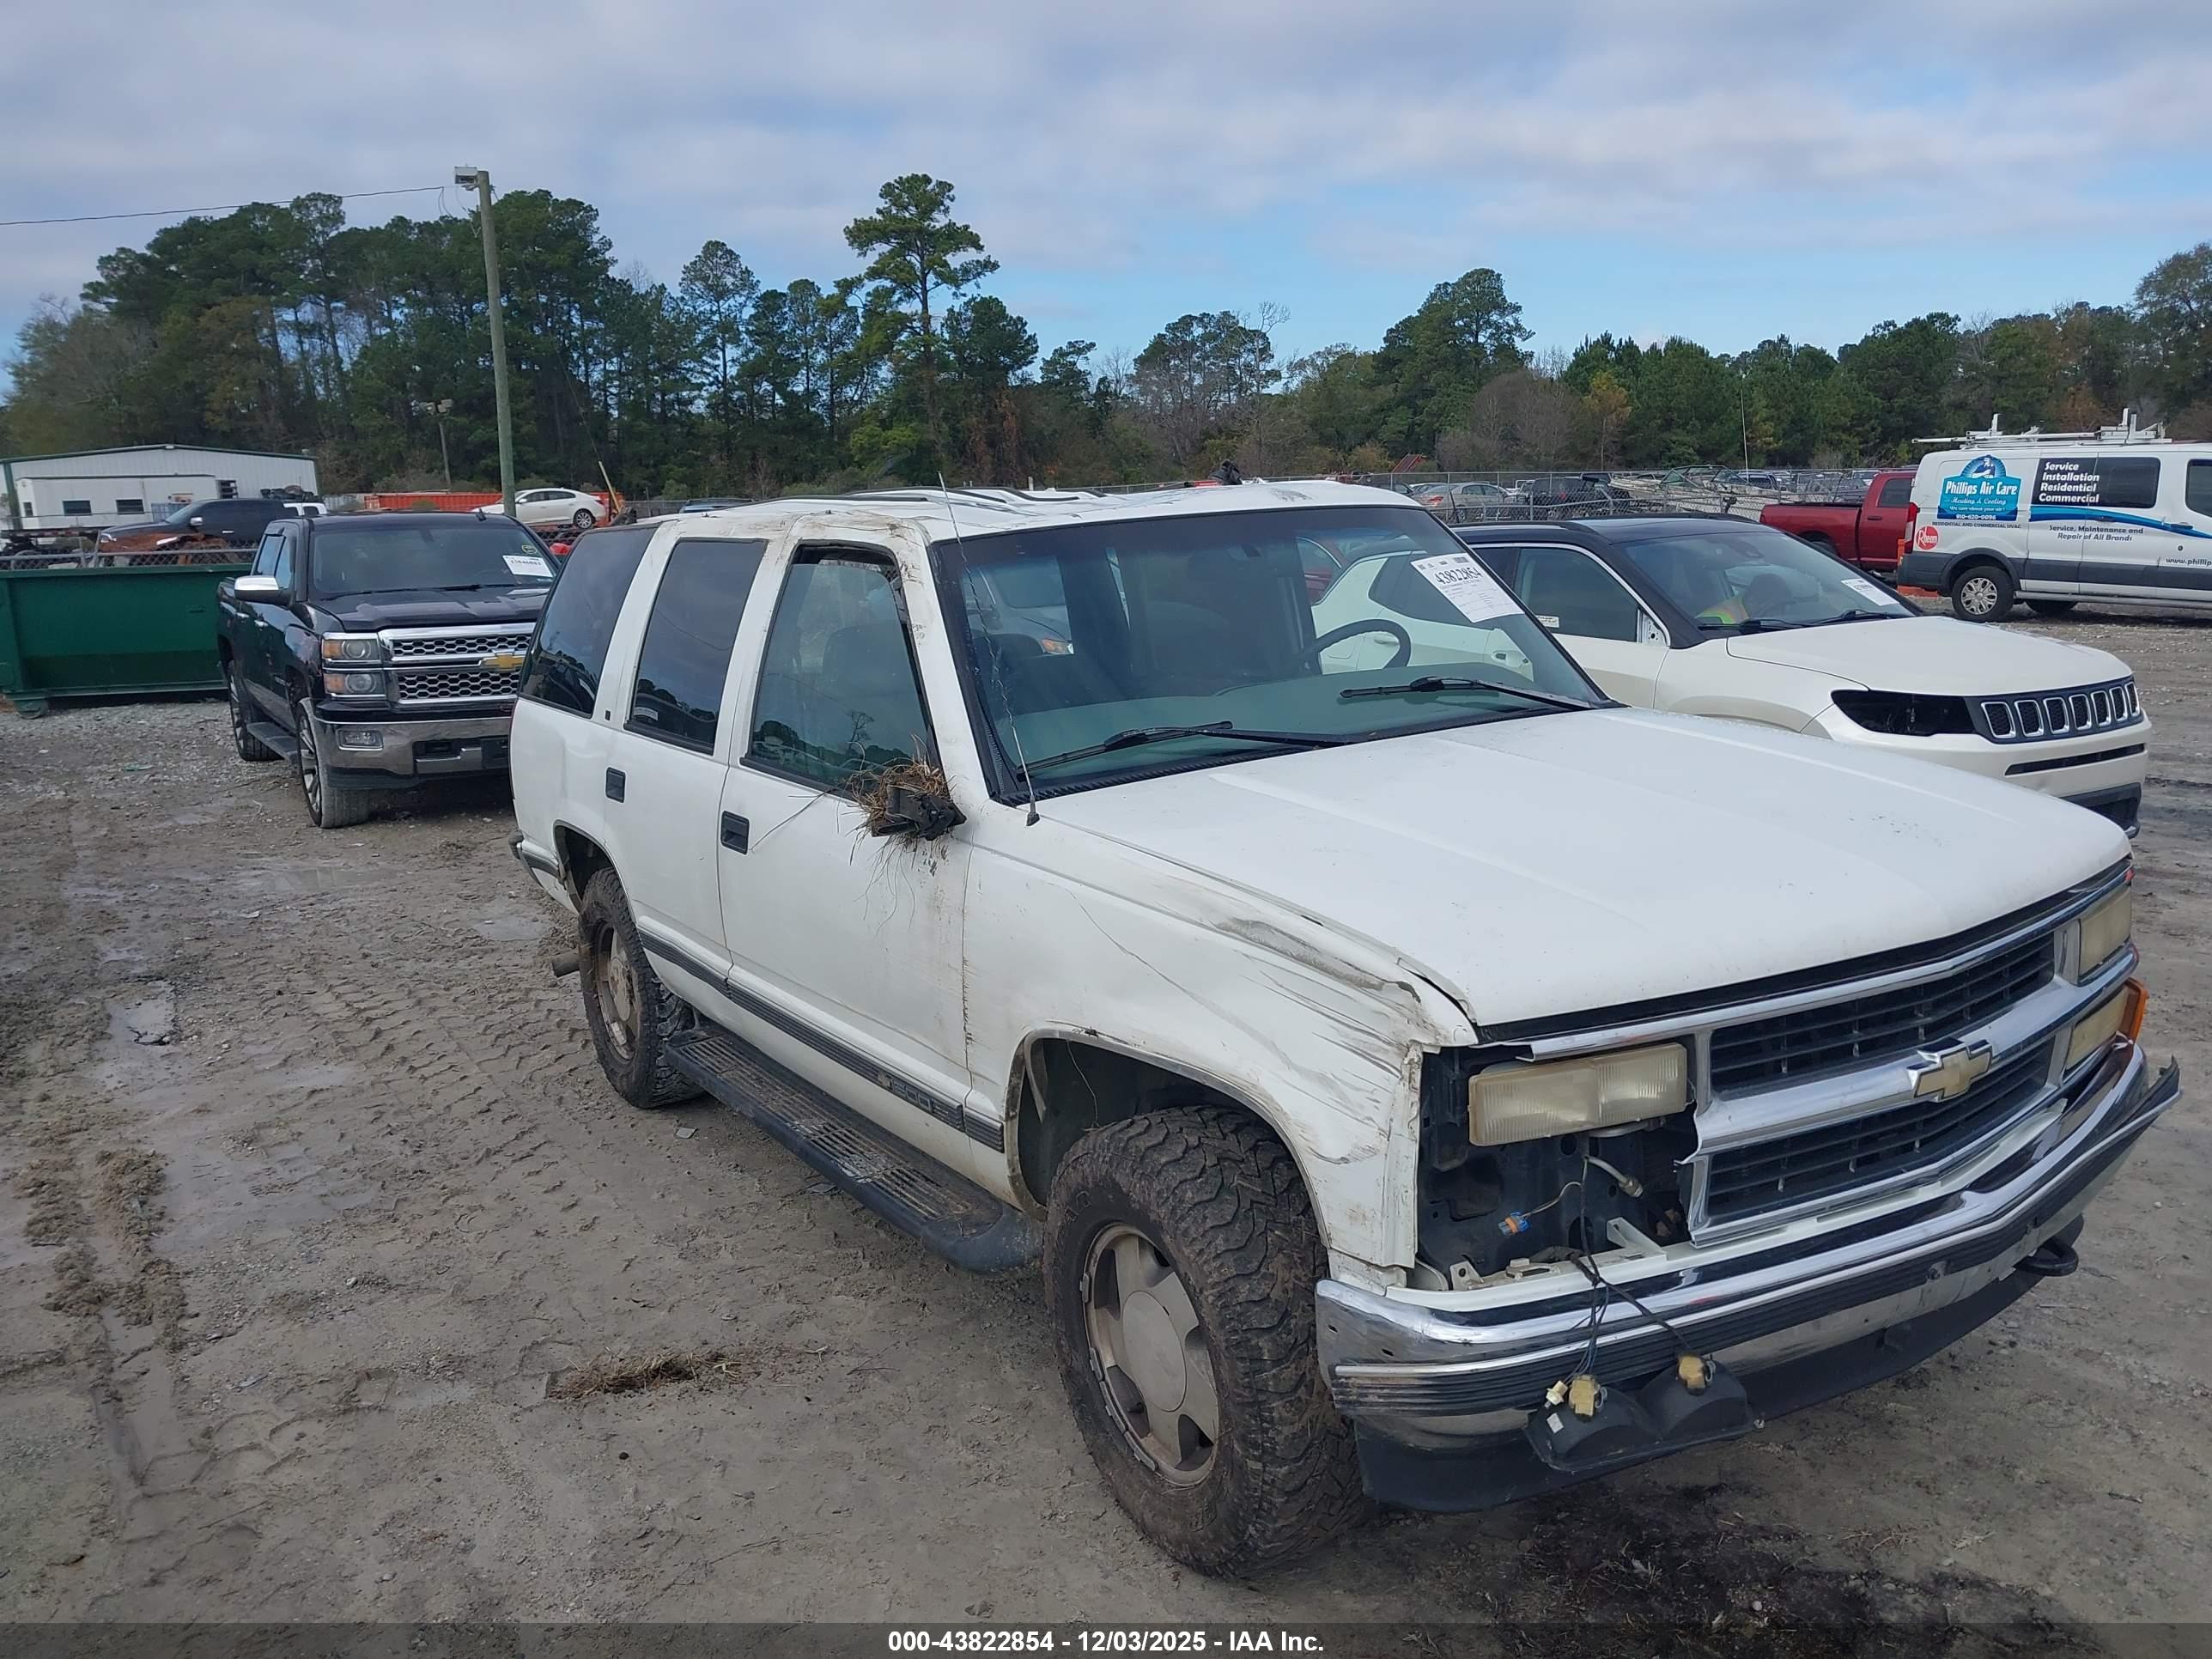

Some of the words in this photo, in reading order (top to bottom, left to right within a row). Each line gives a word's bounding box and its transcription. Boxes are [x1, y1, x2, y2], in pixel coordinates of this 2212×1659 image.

[2045, 461, 2079, 471] Service
[2042, 471, 2100, 481] Installation
[1945, 480, 1977, 495] Phillips
[1980, 481, 1994, 495] Air
[1996, 481, 2018, 495] Care
[2040, 482, 2097, 492] Residential
[2039, 492, 2100, 503] Commercial
[1434, 567, 1483, 585] 43822854
